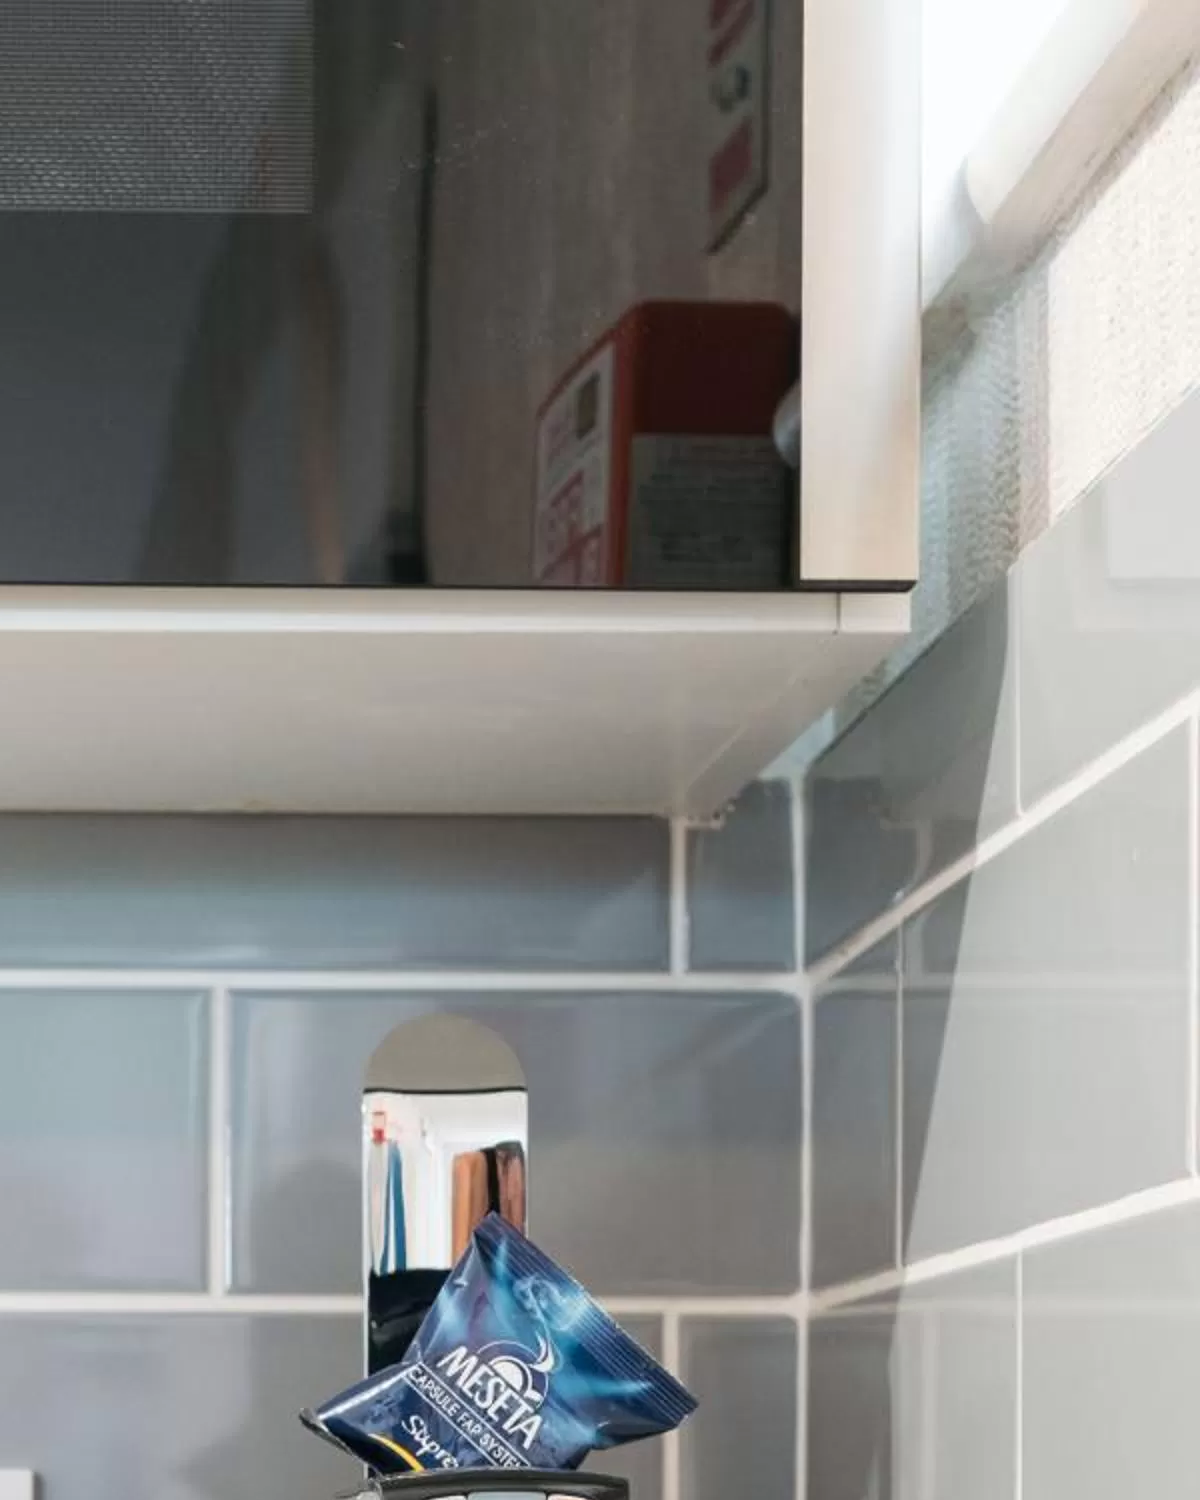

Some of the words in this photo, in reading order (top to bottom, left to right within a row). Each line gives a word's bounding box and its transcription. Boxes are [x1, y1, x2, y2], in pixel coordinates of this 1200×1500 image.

[409, 1367, 461, 1417] CAPSULE
[457, 1412, 482, 1435] FAP
[436, 1346, 544, 1451] MESETA
[401, 1415, 460, 1469] Supre
